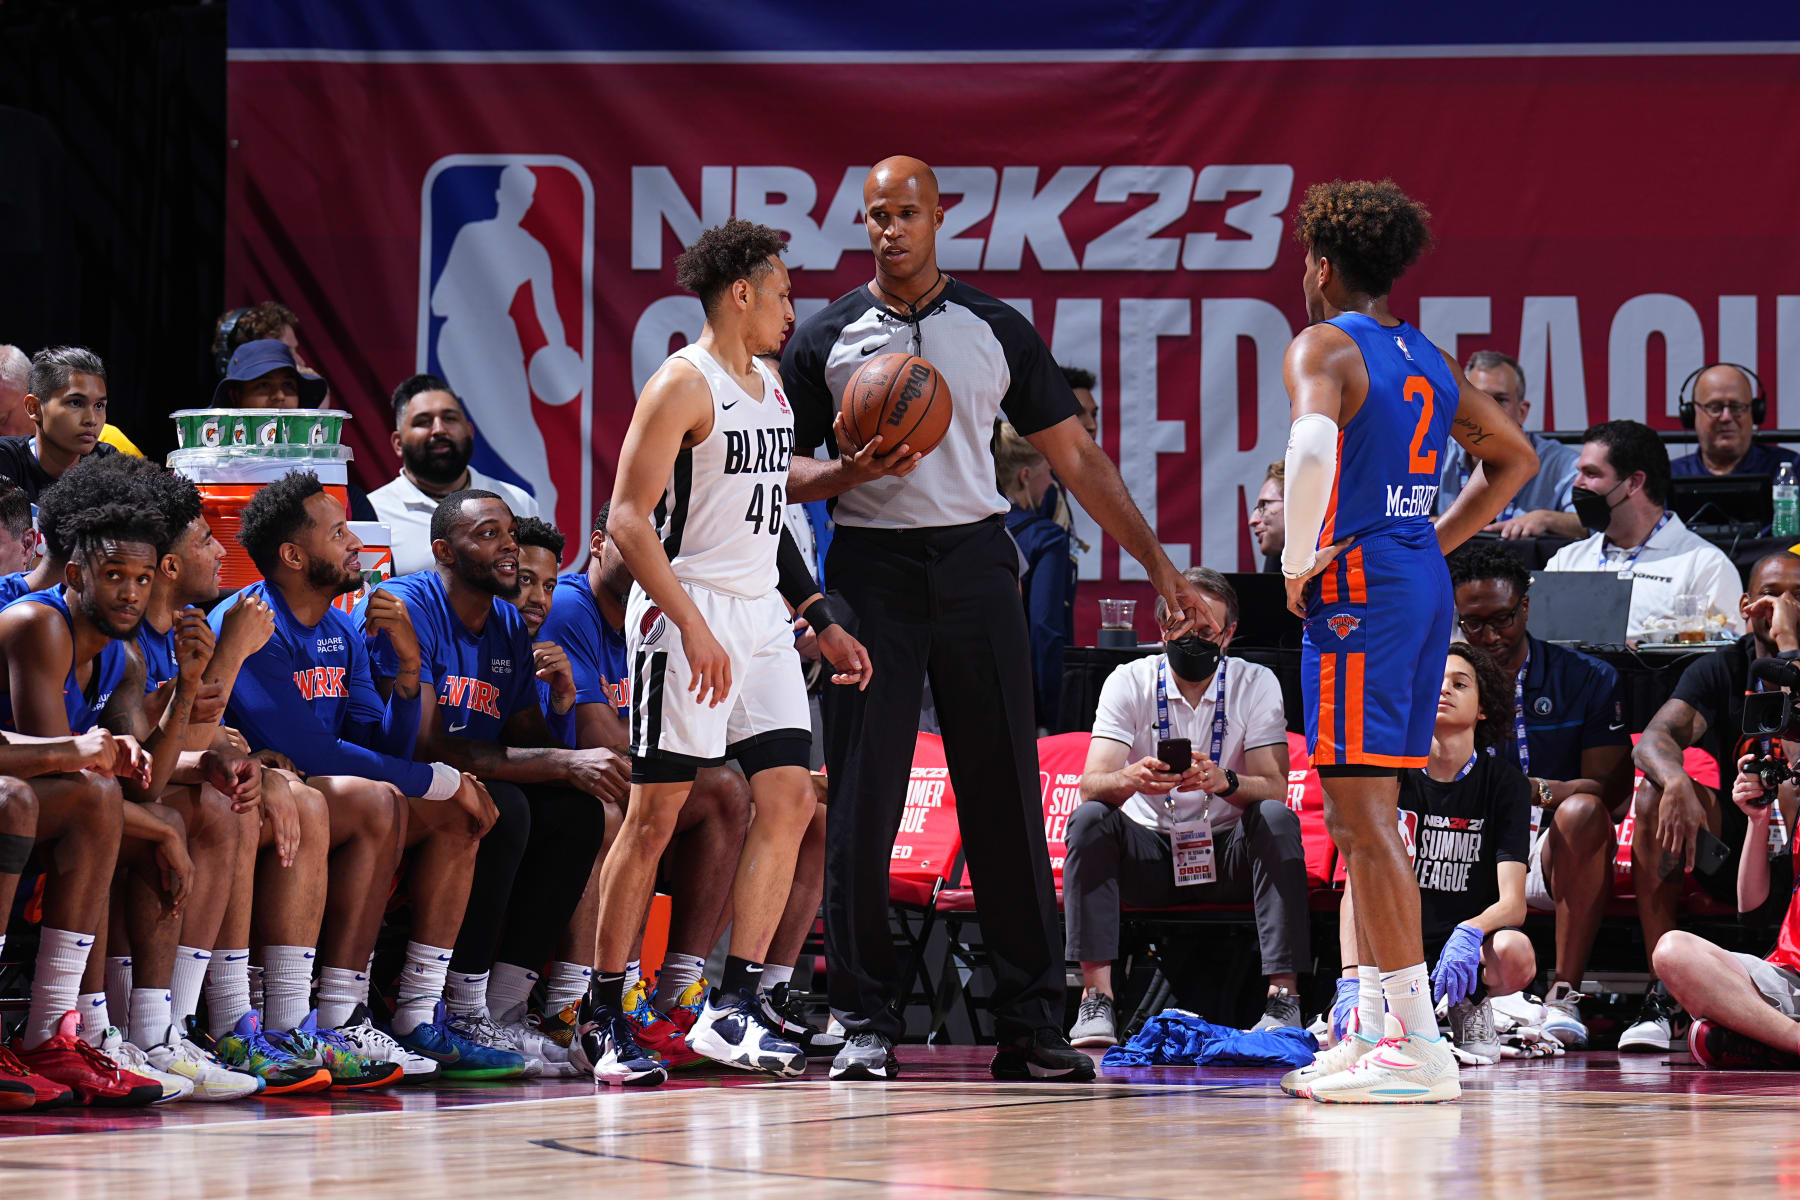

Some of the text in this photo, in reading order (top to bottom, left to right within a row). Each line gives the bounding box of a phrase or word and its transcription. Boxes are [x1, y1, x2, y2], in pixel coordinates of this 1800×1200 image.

[887, 363, 931, 427] Wilson
[1402, 375, 1438, 475] 2
[744, 483, 783, 535] 46
[316, 636, 343, 647] QUARE
[317, 644, 338, 653] PACE
[1420, 829, 1482, 863] SUMMER
